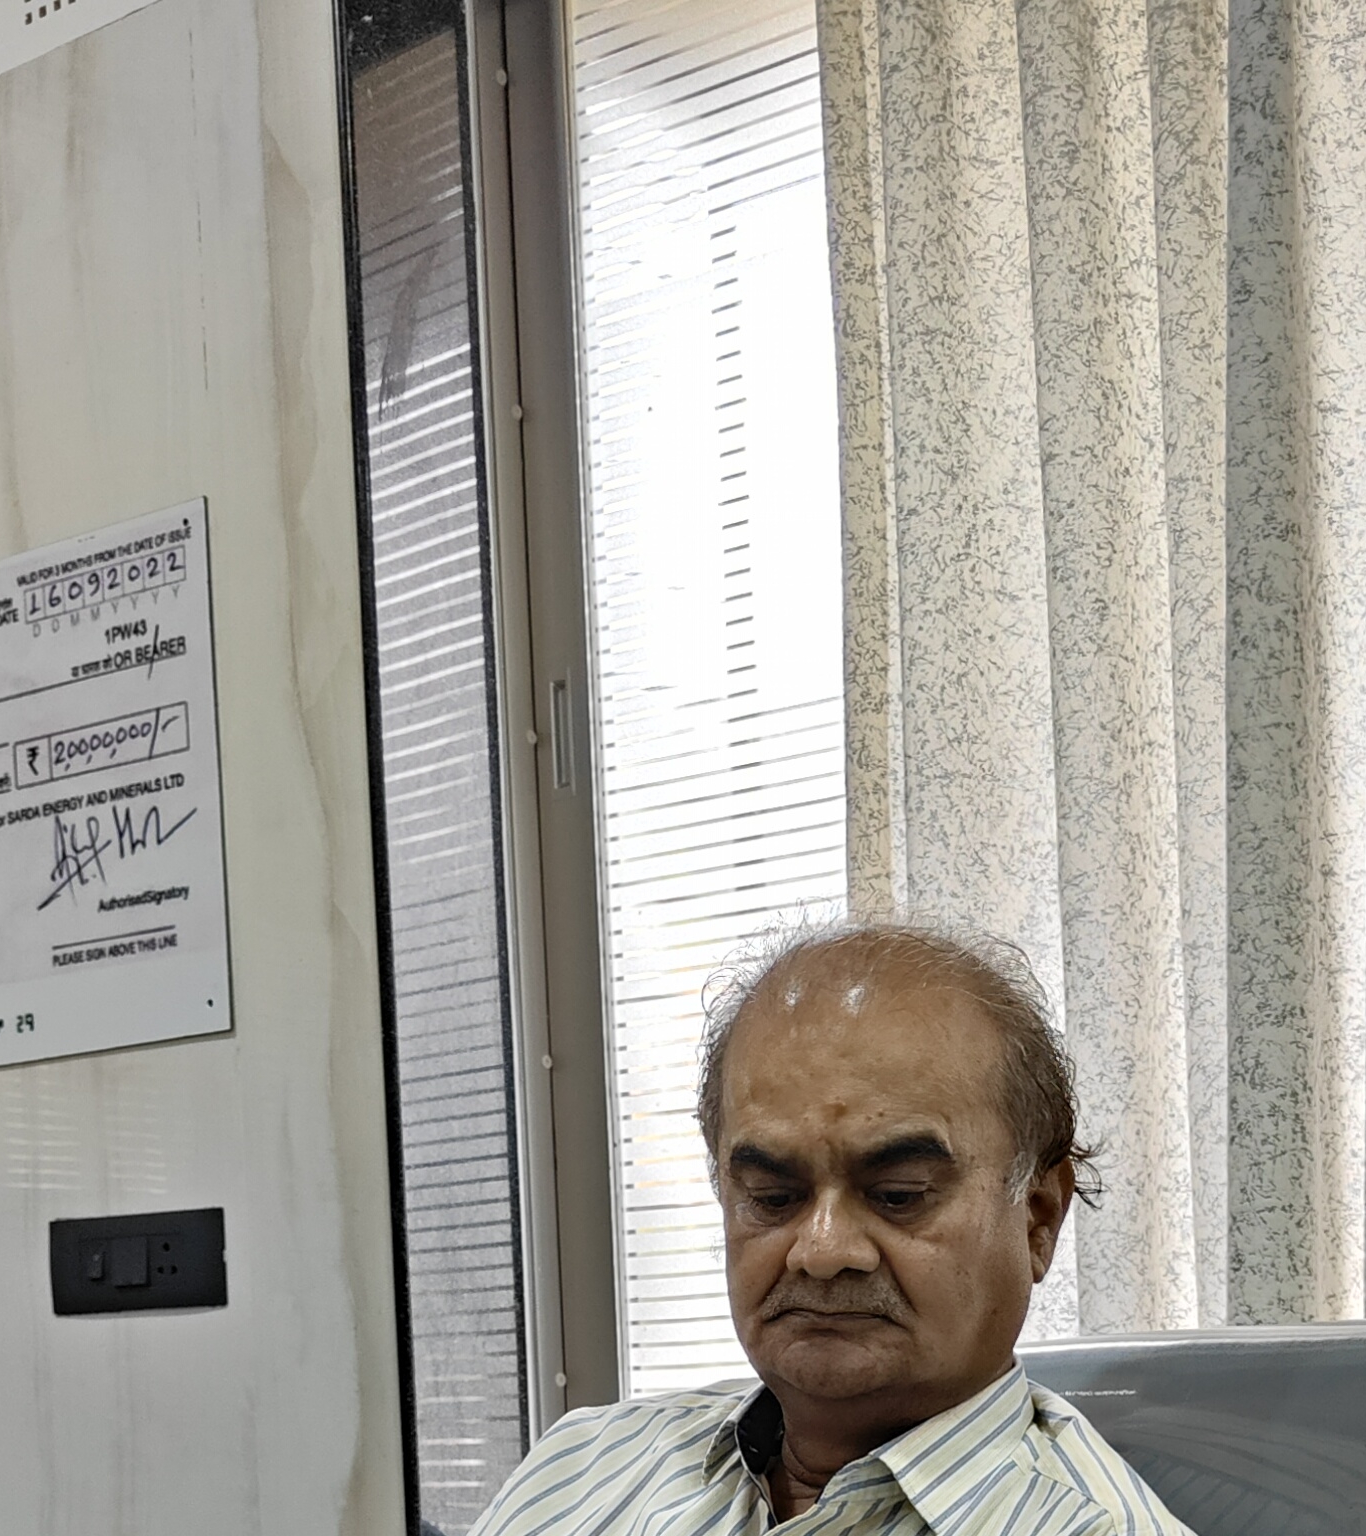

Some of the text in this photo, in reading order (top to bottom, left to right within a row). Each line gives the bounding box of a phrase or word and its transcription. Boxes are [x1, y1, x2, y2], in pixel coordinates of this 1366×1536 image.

[104, 617, 147, 645] 1PW43
[114, 649, 131, 668] OR
[42, 794, 84, 816] ENERGY
[85, 789, 108, 806] AND
[109, 777, 161, 801] MINERALS
[163, 771, 184, 789] LTD
[52, 950, 84, 967] PLEASE
[108, 941, 135, 957] ABOVE
